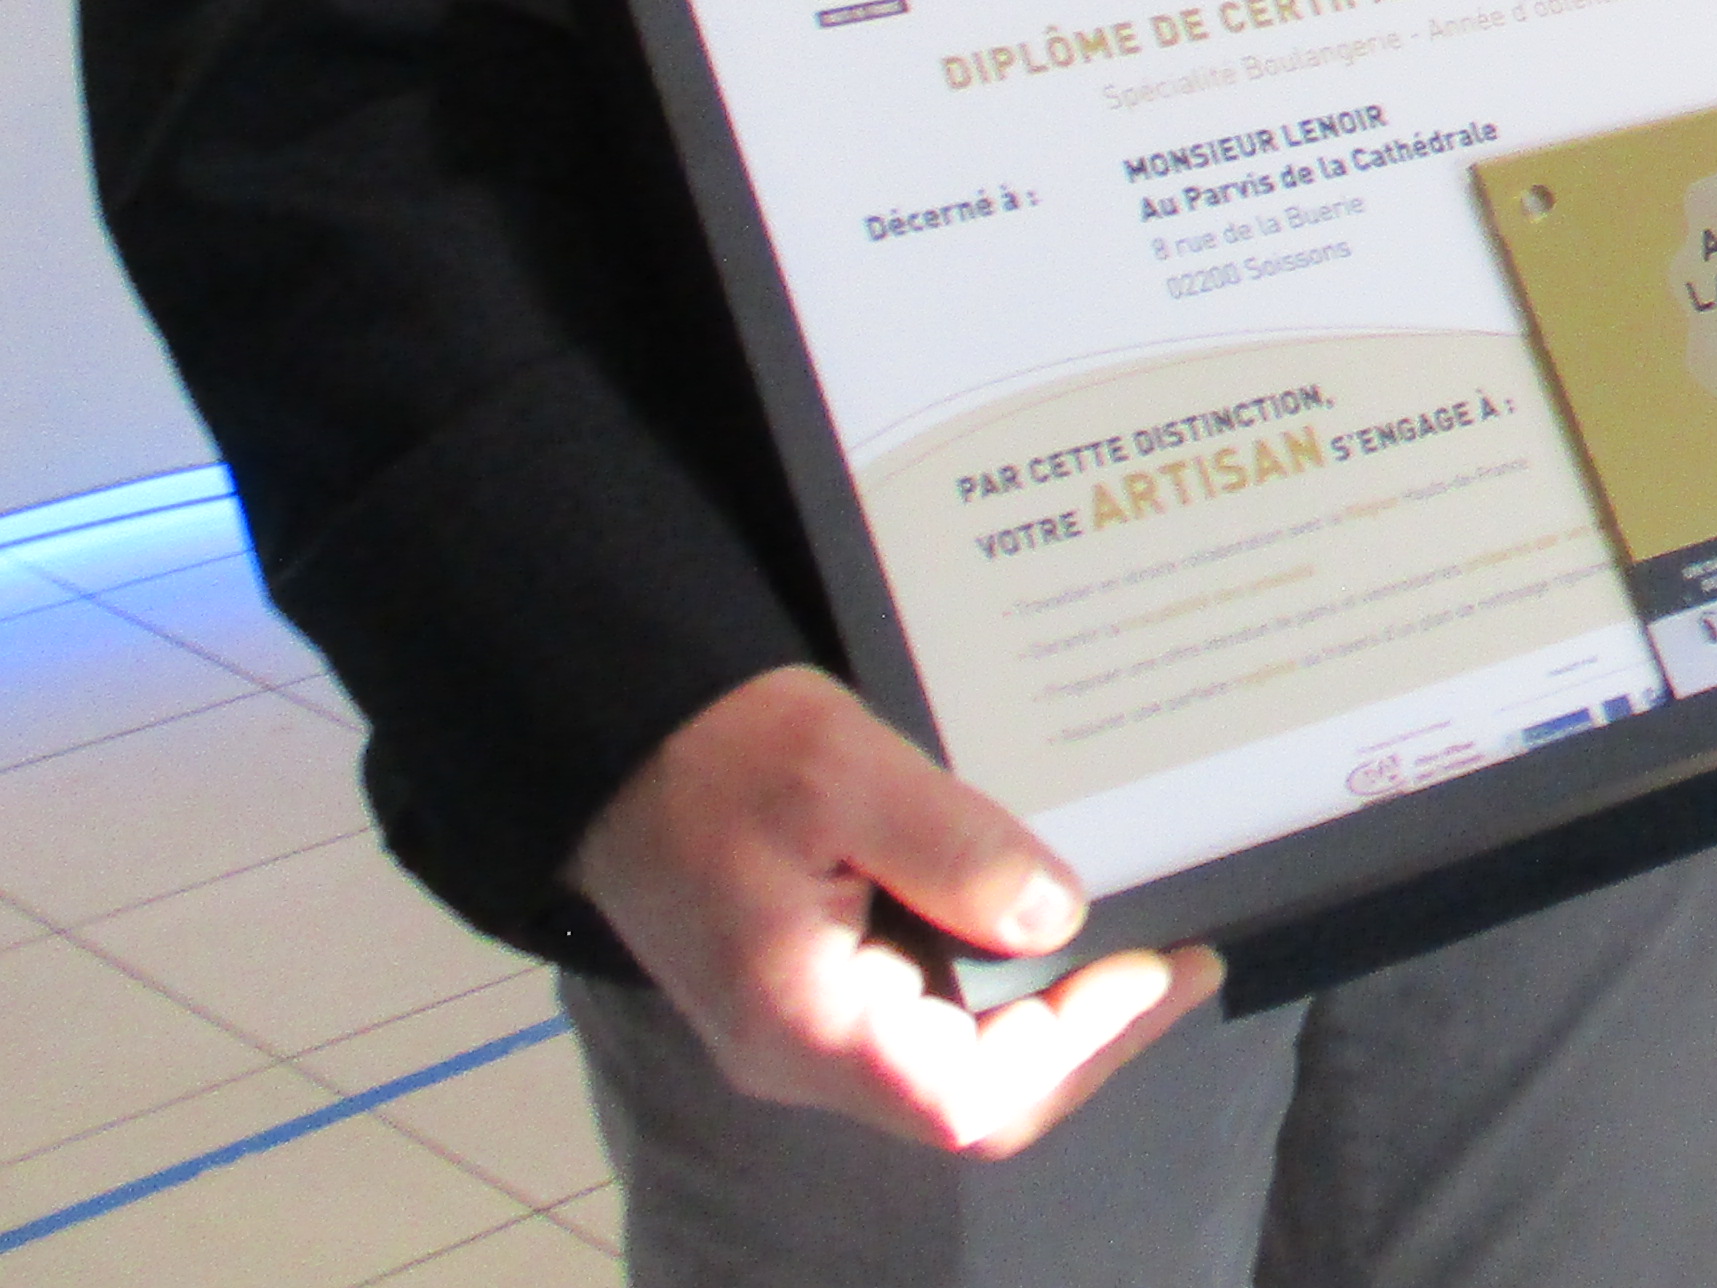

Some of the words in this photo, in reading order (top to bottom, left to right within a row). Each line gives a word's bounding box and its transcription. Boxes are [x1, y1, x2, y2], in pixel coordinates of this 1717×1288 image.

[942, 21, 1141, 89] DIPLÔME
[1150, 7, 1209, 47] DE
[1122, 128, 1278, 183] MONSIEUR
[1281, 104, 1387, 147] LENOIR
[1140, 197, 1179, 222] Au
[1181, 173, 1276, 211] Parvis
[1278, 164, 1315, 189] de
[1317, 156, 1348, 179] la
[1349, 122, 1498, 171] Cathédrale
[863, 189, 994, 242] Décerné
[1000, 185, 1020, 212] à
[957, 464, 1021, 501] PAR
[1029, 436, 1128, 482] CETTE
[1134, 386, 1333, 455] DISTINCTION,
[976, 511, 1082, 558] VOTRE
[1092, 424, 1326, 531] ARTISAN
[1330, 401, 1473, 461] S'ENGAGE
